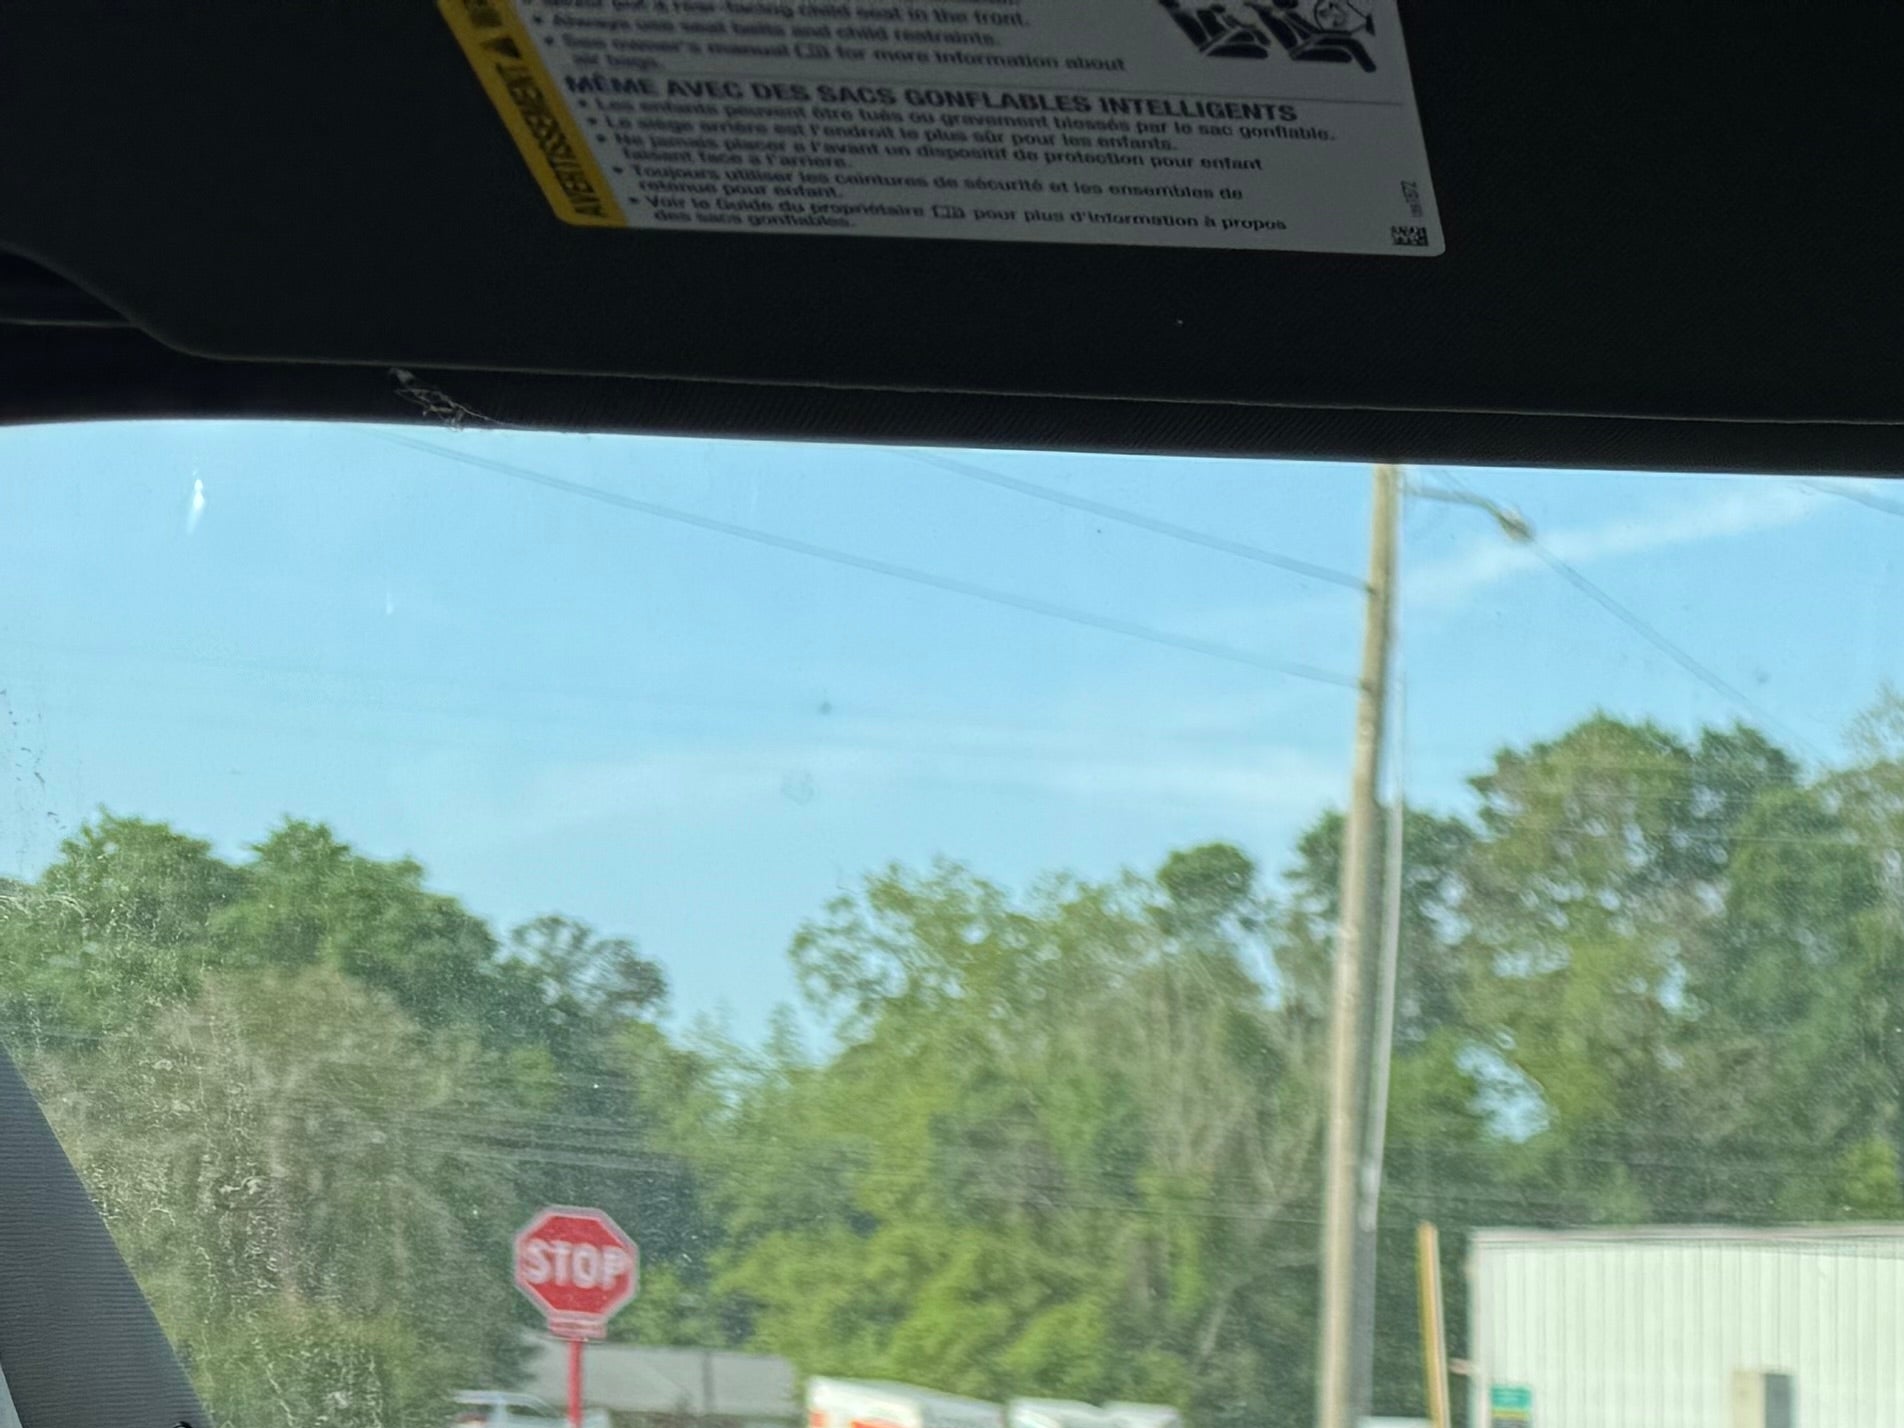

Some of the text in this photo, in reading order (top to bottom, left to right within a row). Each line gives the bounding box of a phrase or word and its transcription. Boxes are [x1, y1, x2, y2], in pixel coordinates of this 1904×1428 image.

[874, 49, 928, 64] more
[934, 50, 1058, 69] information
[1066, 54, 1127, 72] about
[667, 79, 744, 98] AVEC
[751, 82, 811, 102] DES
[816, 85, 897, 106] SACS
[905, 87, 1091, 114] GONFLABLES
[1101, 95, 1298, 122] INTELLIGENTS
[1136, 119, 1169, 135] par
[1198, 123, 1232, 137] sac
[1150, 156, 1262, 171] pour enfant
[974, 208, 1016, 223] pour
[1024, 208, 1064, 224] plus
[1070, 210, 1198, 228] d'information
[1221, 217, 1288, 232] propos
[522, 1239, 627, 1291] STOP
